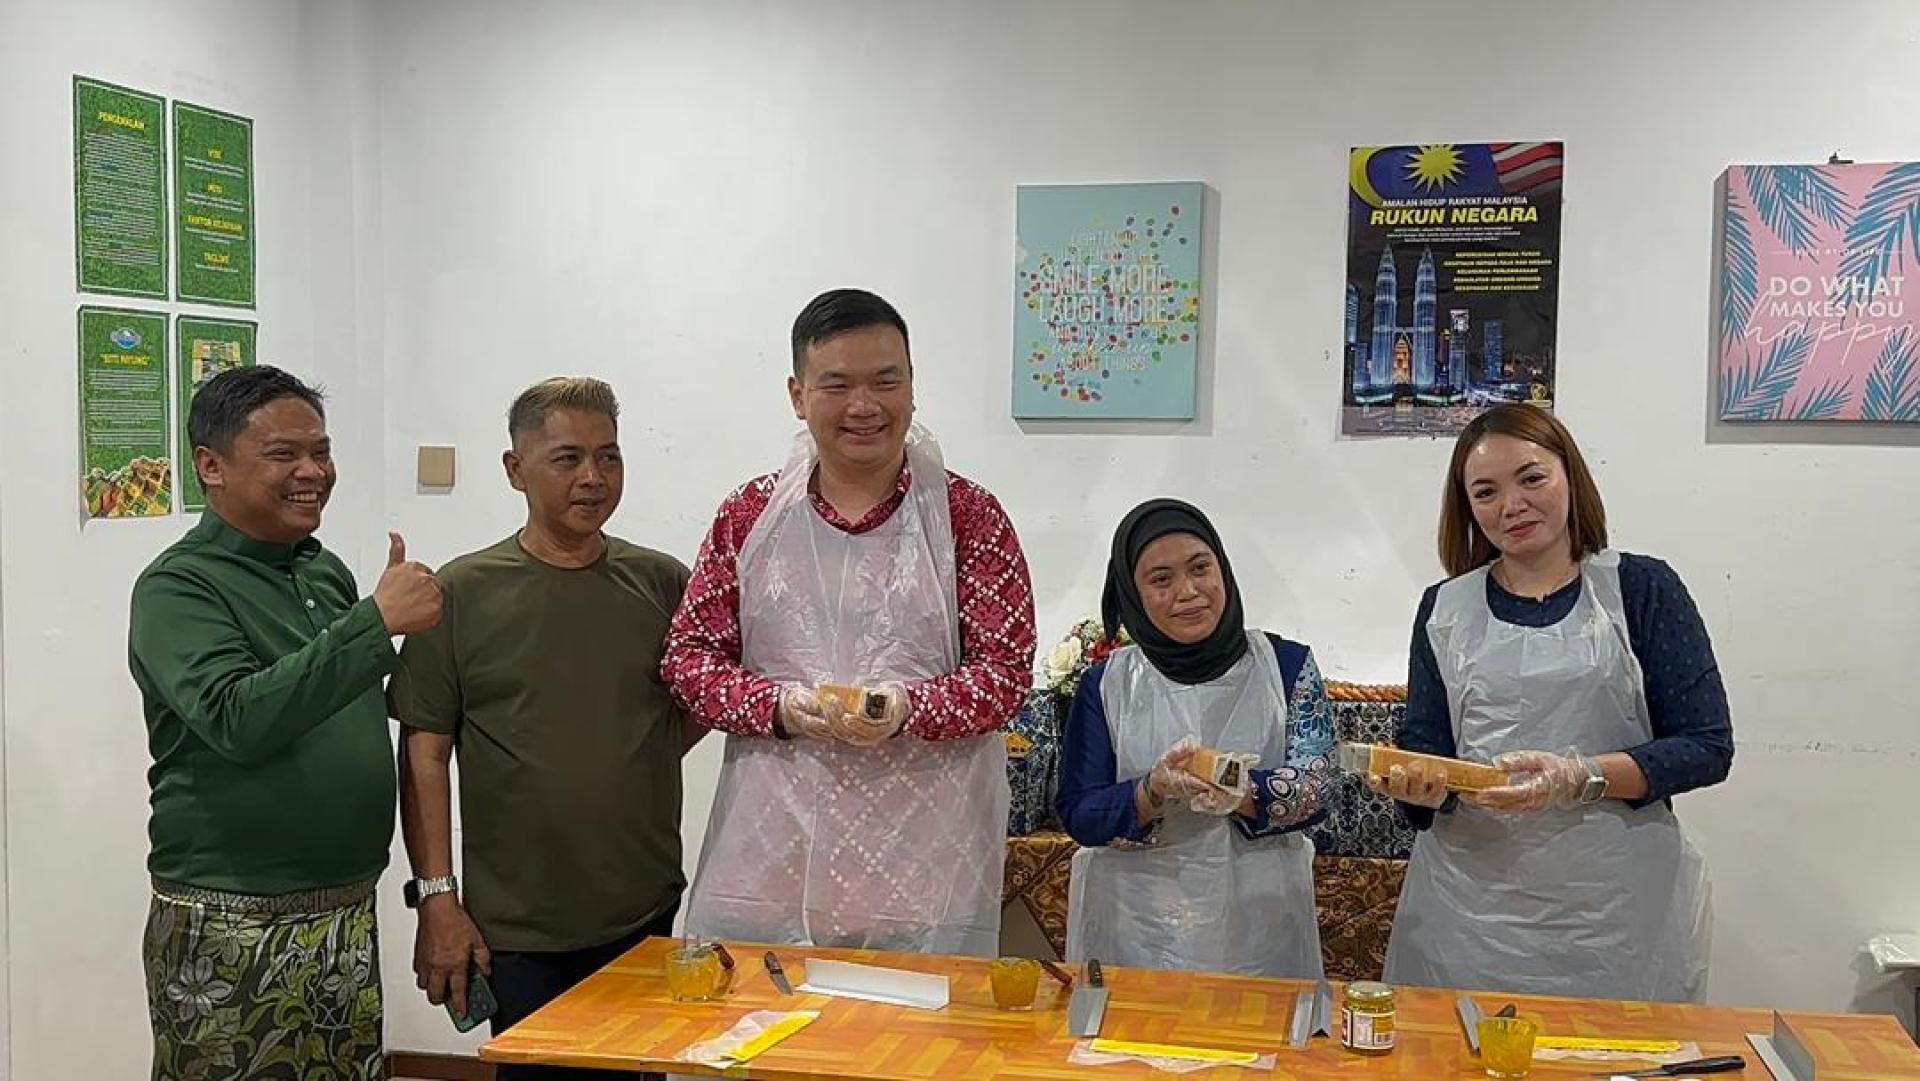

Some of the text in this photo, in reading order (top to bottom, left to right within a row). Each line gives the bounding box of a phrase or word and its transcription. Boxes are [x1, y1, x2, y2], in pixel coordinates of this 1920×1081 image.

[1419, 198, 1447, 206] HIDUP
[1448, 197, 1482, 206] RAKYAT
[1482, 196, 1528, 205] MALAYSIA
[1370, 206, 1538, 225] RUKUN NEGARA
[1110, 264, 1170, 294] MORE
[1769, 275, 1905, 296] DO WHAT
[1039, 295, 1170, 323] LAUGH MORE
[1769, 301, 1904, 318] MAKES YOU
[1744, 287, 1920, 372] happy
